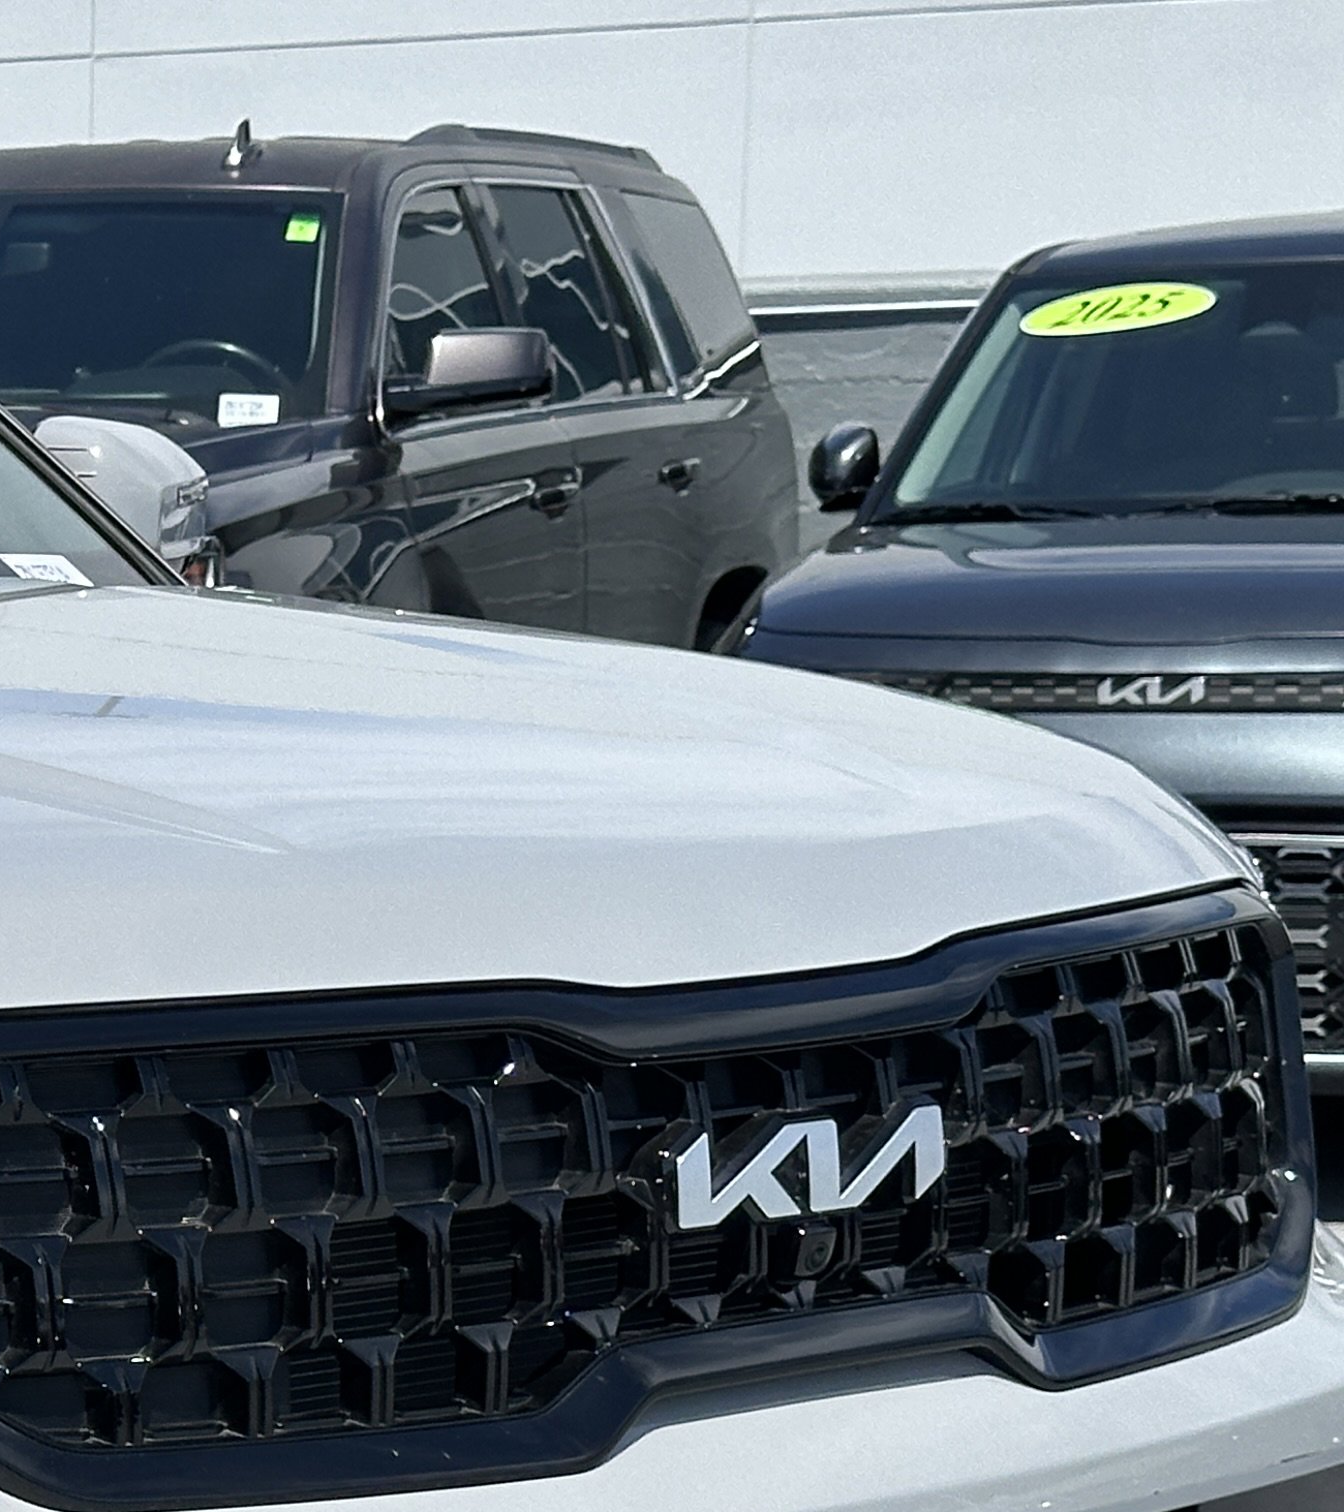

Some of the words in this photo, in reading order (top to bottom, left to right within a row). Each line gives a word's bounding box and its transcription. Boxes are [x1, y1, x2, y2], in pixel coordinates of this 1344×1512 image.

[1048, 289, 1185, 329] 2025
[1097, 676, 1205, 705] KIA
[677, 1105, 944, 1229] KIA
